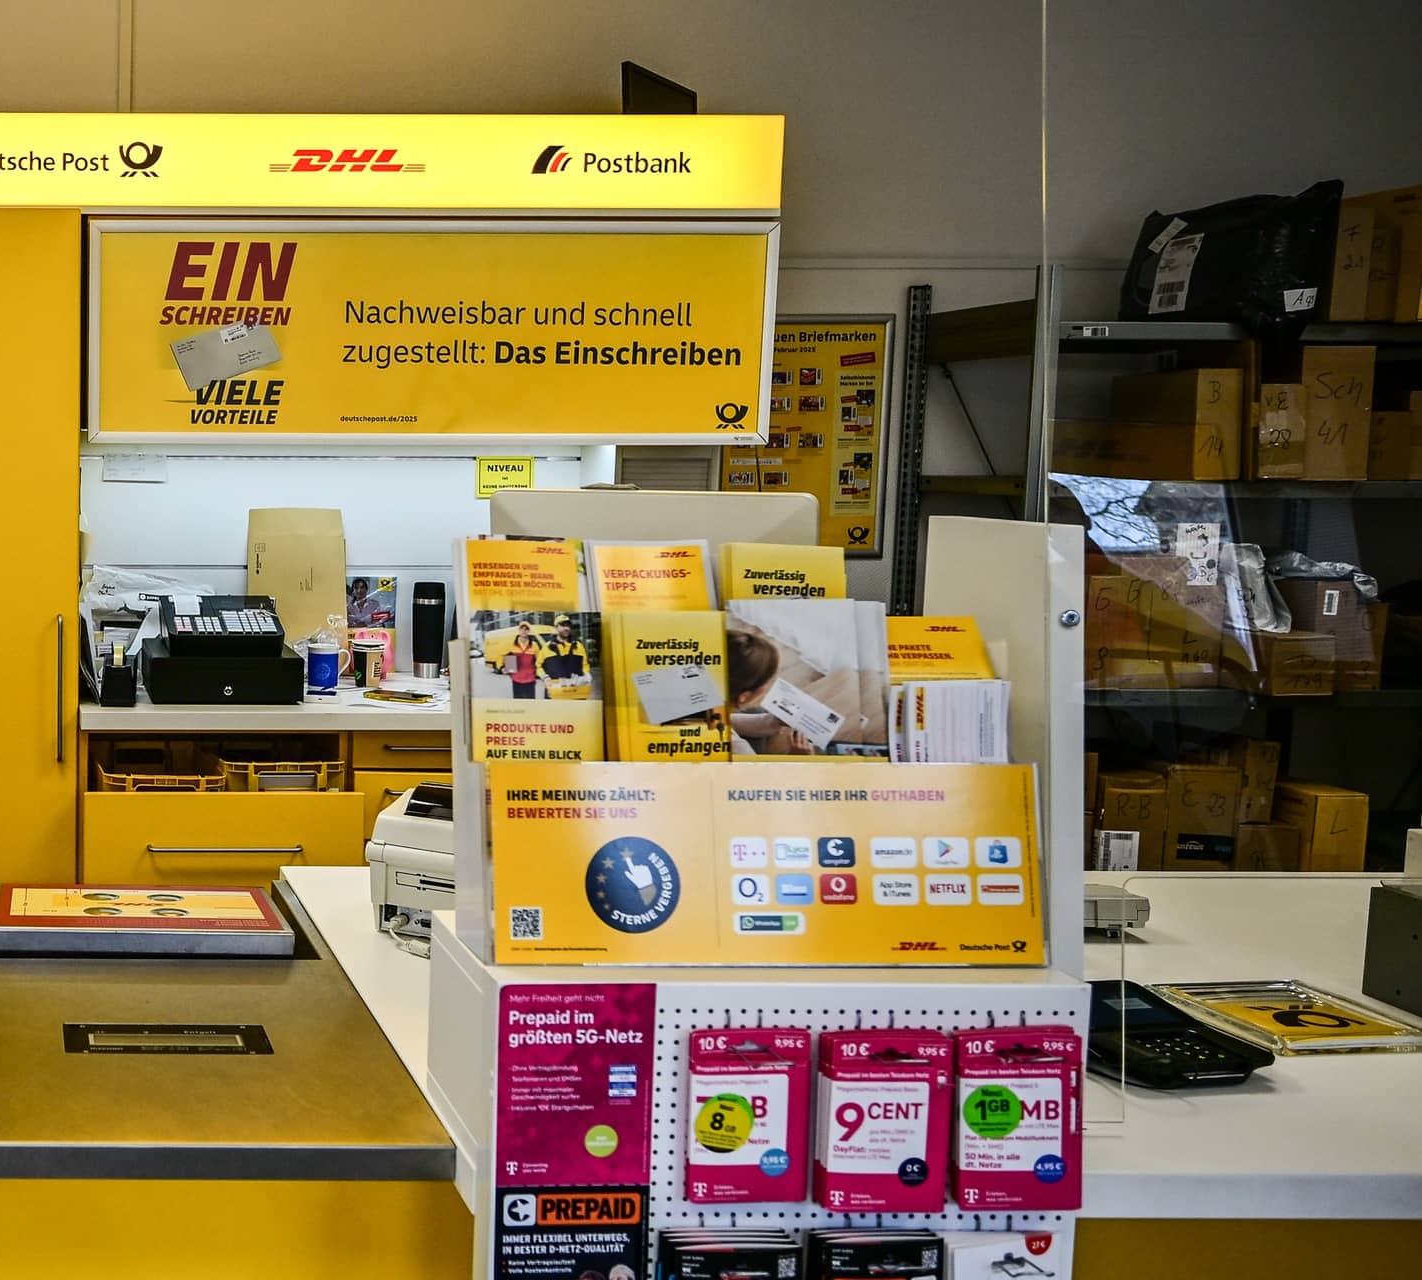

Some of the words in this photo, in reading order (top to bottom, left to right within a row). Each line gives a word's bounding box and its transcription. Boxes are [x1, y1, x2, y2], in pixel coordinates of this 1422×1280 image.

[63, 152, 109, 171] Post
[290, 149, 404, 172] DHL
[583, 151, 692, 174] Postbank
[164, 242, 298, 301] EIN
[159, 305, 291, 326] SCHREIBEN
[345, 299, 525, 325] Nachweisbar
[535, 302, 585, 326] und
[594, 302, 691, 327] schnell
[799, 331, 876, 342] Briefmarken
[342, 340, 485, 369] zugestellt:
[495, 341, 546, 364] Das
[555, 341, 741, 366] Einschreiben
[195, 380, 284, 405] VIELE
[190, 409, 277, 425] VORTEILE
[340, 415, 418, 423] deutschepost.de/2025
[603, 568, 691, 579] VERPACKUNGS-
[744, 569, 806, 583] Zuverlässig
[604, 581, 637, 592] TIPPS
[753, 584, 825, 597] versenden
[636, 639, 699, 653] Zuverlässig
[646, 652, 721, 666] versenden
[486, 723, 546, 734] PRODUKTE
[550, 724, 574, 734] UND
[680, 727, 701, 737] und
[486, 736, 525, 746] PREISE
[648, 738, 731, 756] empfangen
[486, 749, 508, 760] AUF
[511, 749, 546, 760] EINEN
[548, 750, 582, 761] BLICK
[507, 790, 538, 801] IHRE
[542, 790, 606, 801] MEINUNG
[610, 787, 655, 802] ZÄHLT:
[728, 790, 782, 801] KAUFEN
[786, 790, 806, 801] SIE
[810, 790, 842, 801] HIER
[845, 790, 867, 801] IHR
[871, 790, 945, 801] GUTHABEN
[507, 808, 581, 819] BEWERTEN
[585, 808, 606, 819] SIE
[609, 808, 638, 819] UNS
[648, 852, 673, 912] VERGEBEN
[930, 884, 966, 893] NETFLIX
[611, 909, 658, 926] STERNE
[899, 942, 938, 950] DHL
[564, 995, 582, 1003] geht
[509, 1010, 570, 1027] Prepaid
[574, 1010, 594, 1024] im
[508, 1029, 572, 1048] größten
[576, 1029, 643, 1044] 5G-Netz
[698, 1037, 714, 1050] 10
[716, 1037, 727, 1049] €
[775, 1039, 794, 1048] 9,95
[841, 1043, 857, 1056] 10
[859, 1043, 870, 1056] €
[965, 1041, 982, 1054] 10
[984, 1040, 995, 1053] €
[1043, 1041, 1064, 1051] 9,95
[710, 1113, 725, 1131] 8
[835, 1102, 865, 1142] 9
[868, 1103, 923, 1119] CENT
[541, 1198, 635, 1220] PREPAID
[503, 1235, 530, 1243] IMMER
[533, 1234, 573, 1242] FLEXIBEL
[576, 1233, 630, 1243] UNTERWEGS,
[503, 1246, 512, 1254] IN
[514, 1245, 546, 1254] BESTER
